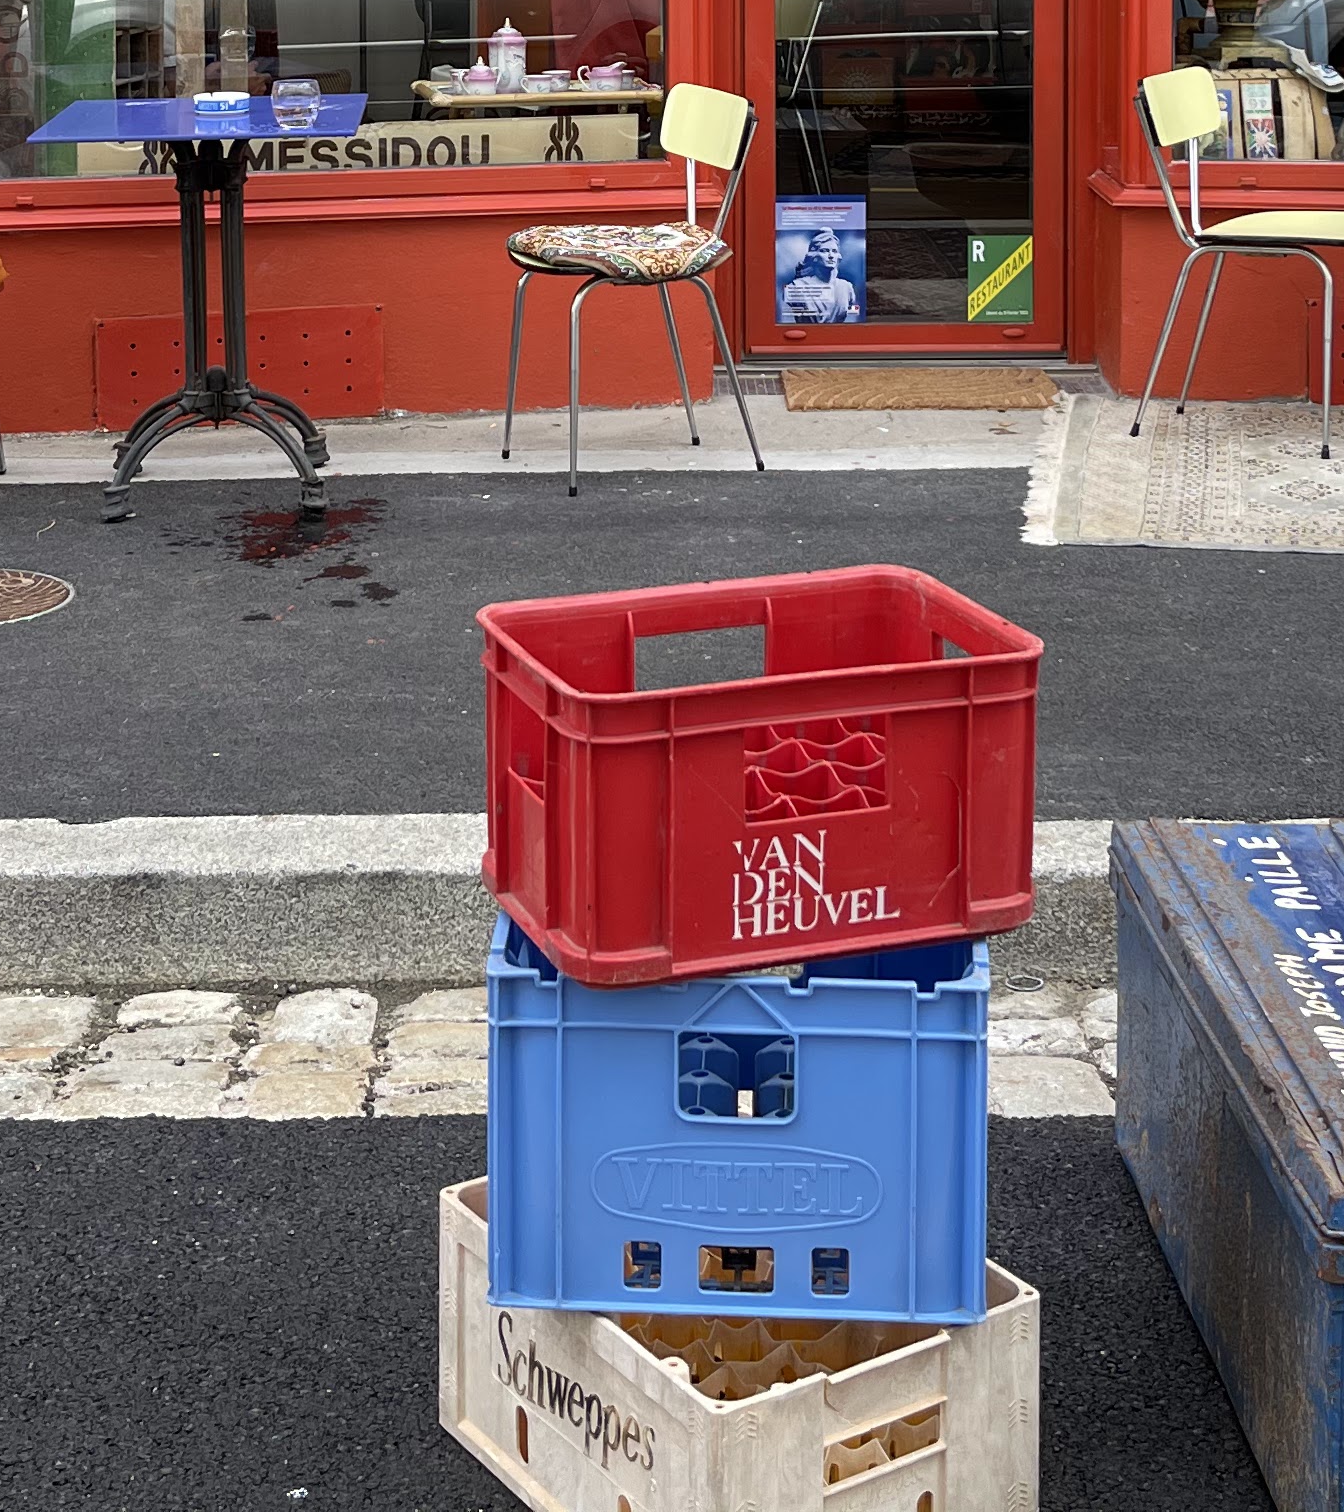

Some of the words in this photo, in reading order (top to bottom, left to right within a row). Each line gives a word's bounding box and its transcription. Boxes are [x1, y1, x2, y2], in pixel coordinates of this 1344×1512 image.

[969, 242, 1031, 315] RESTAURANT
[972, 240, 986, 263] R
[732, 829, 827, 872] VAN
[732, 857, 825, 906] DEN
[731, 885, 902, 941] HEUVEL
[611, 1156, 864, 1218] VITTEL
[497, 1310, 656, 1471] Schweppes
